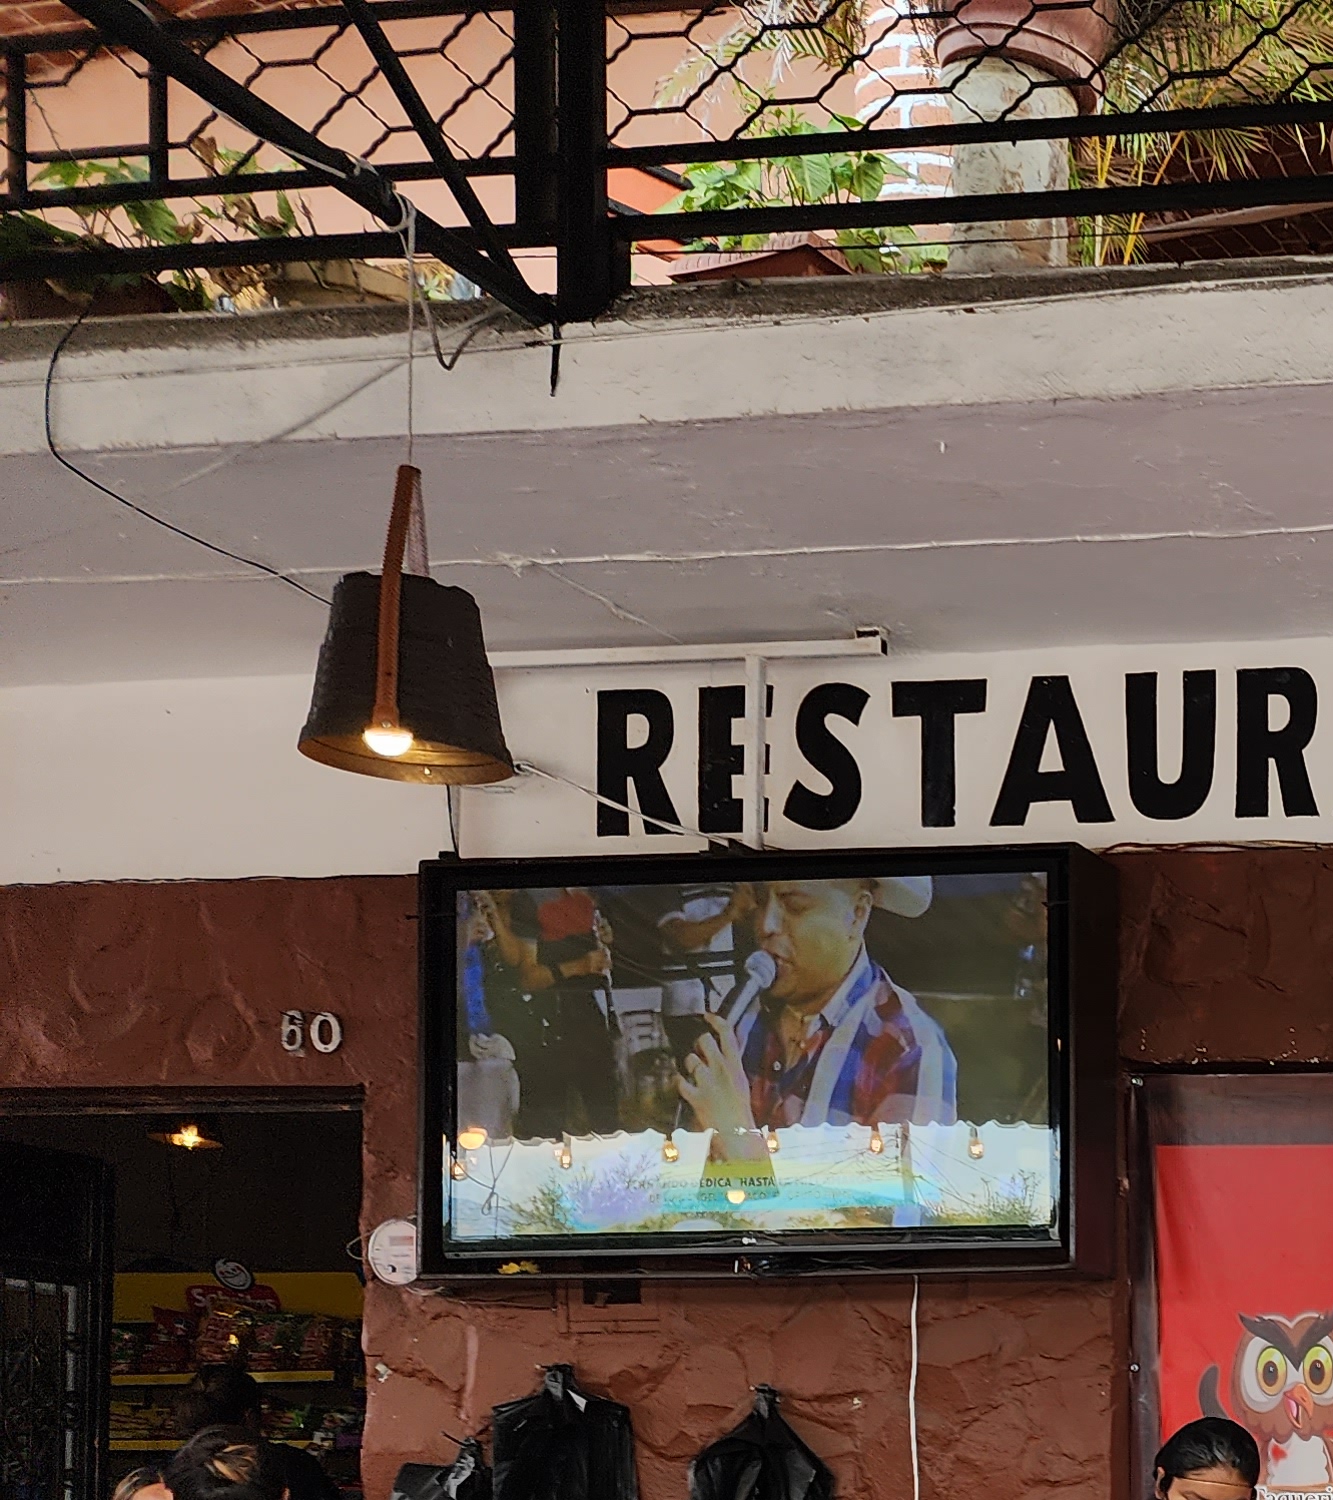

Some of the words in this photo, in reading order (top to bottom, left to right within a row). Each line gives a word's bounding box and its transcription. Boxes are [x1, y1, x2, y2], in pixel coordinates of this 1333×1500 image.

[280, 1010, 342, 1054] 60
[693, 1177, 732, 1188] EDICA
[740, 1176, 775, 1187] HASTA
